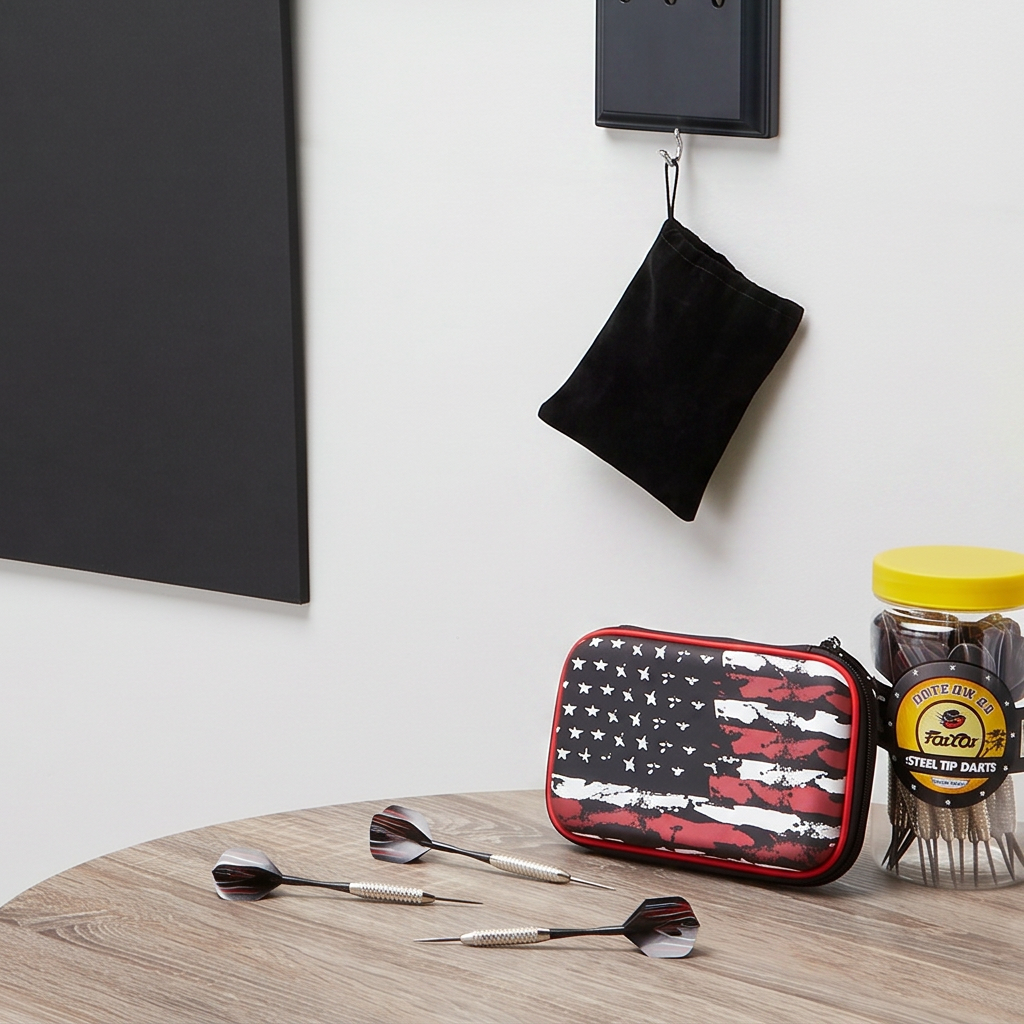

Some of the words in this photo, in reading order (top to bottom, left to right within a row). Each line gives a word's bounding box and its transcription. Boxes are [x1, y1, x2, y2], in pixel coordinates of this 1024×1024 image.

[907, 756, 938, 770] STEEL
[940, 760, 958, 772] TIP
[960, 761, 997, 773] DARTS
